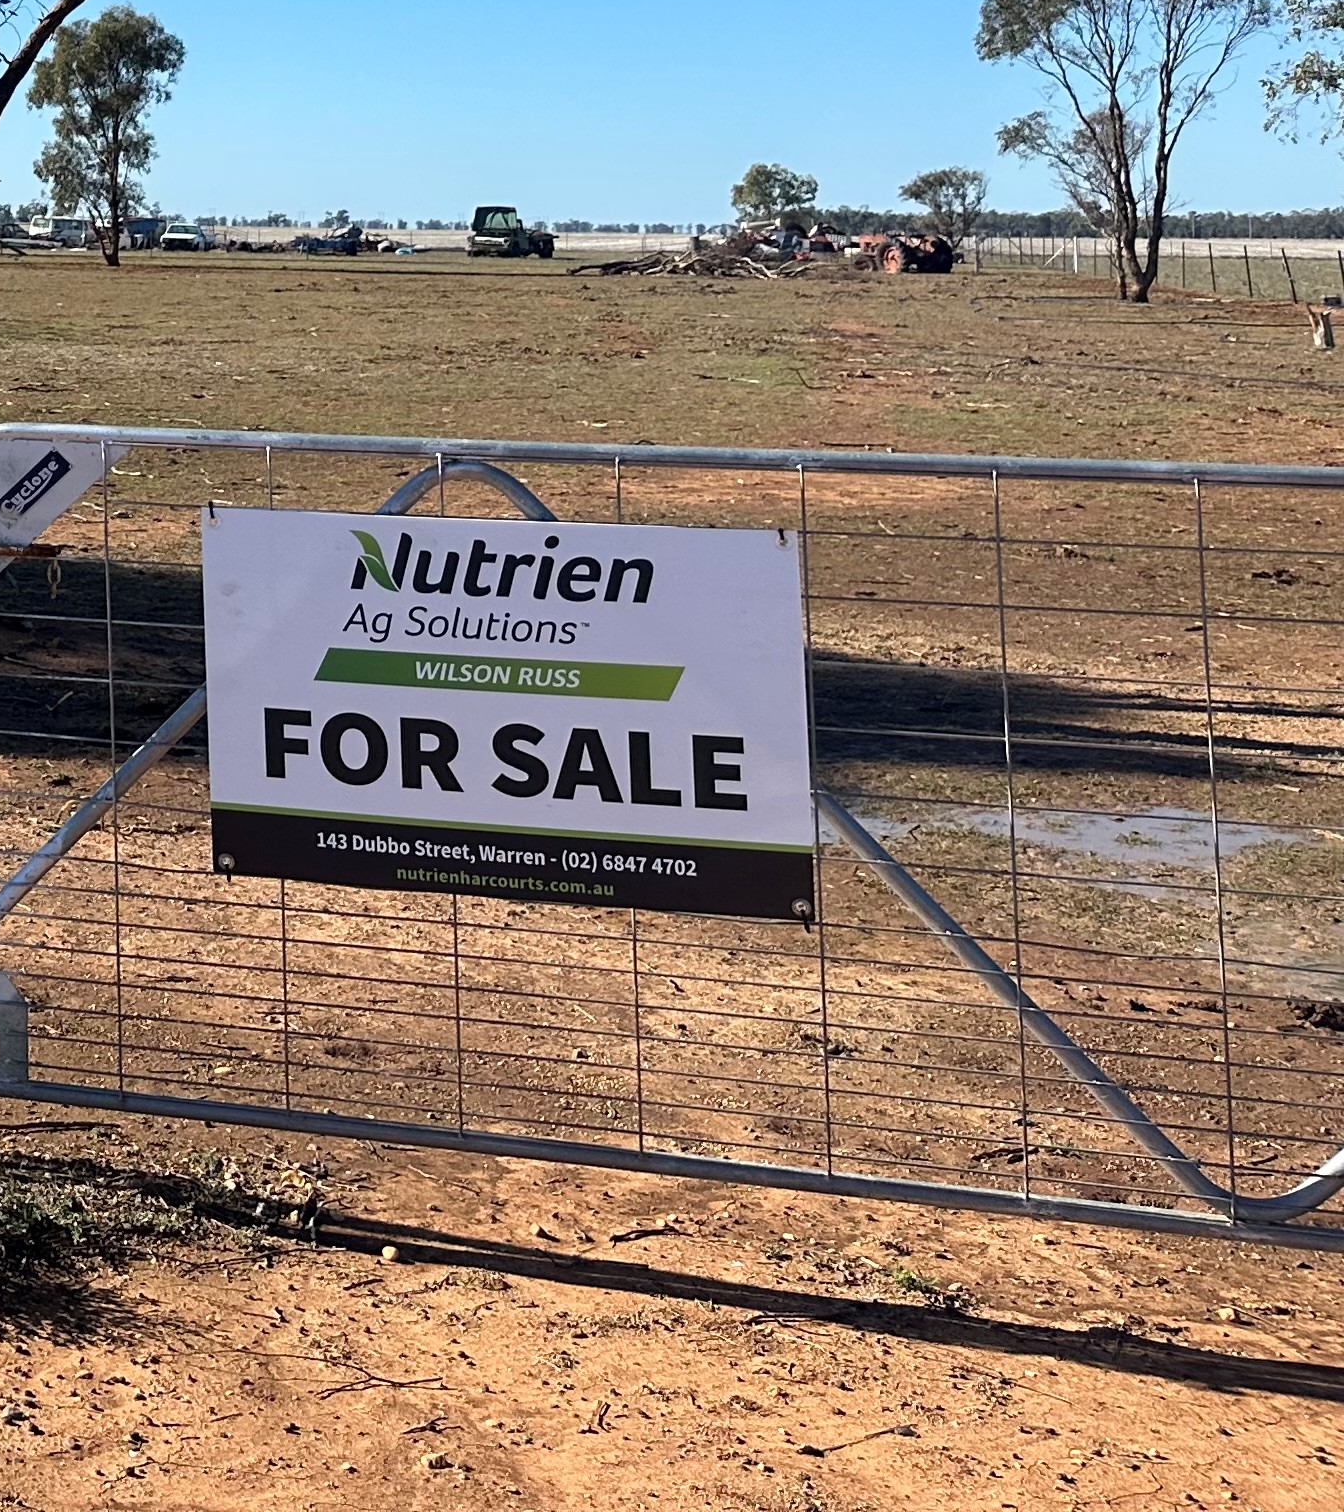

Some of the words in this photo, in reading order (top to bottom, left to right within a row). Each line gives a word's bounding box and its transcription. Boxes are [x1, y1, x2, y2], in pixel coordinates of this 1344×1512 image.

[0, 460, 59, 514] Cyclone
[349, 530, 655, 604] Nutrien
[342, 603, 393, 644] Ag
[414, 661, 512, 686] WILSON
[517, 666, 582, 689] RUSS
[263, 707, 465, 793] FOR
[490, 722, 749, 812] SALE
[316, 831, 348, 850] 143
[352, 834, 411, 856] Dubbo
[414, 839, 476, 865] Street,
[478, 844, 546, 867] Warren
[561, 849, 598, 874] (02)
[602, 854, 647, 874] 6847
[651, 857, 698, 877] 4702
[396, 867, 615, 897] nutrienharcourts.com.au
